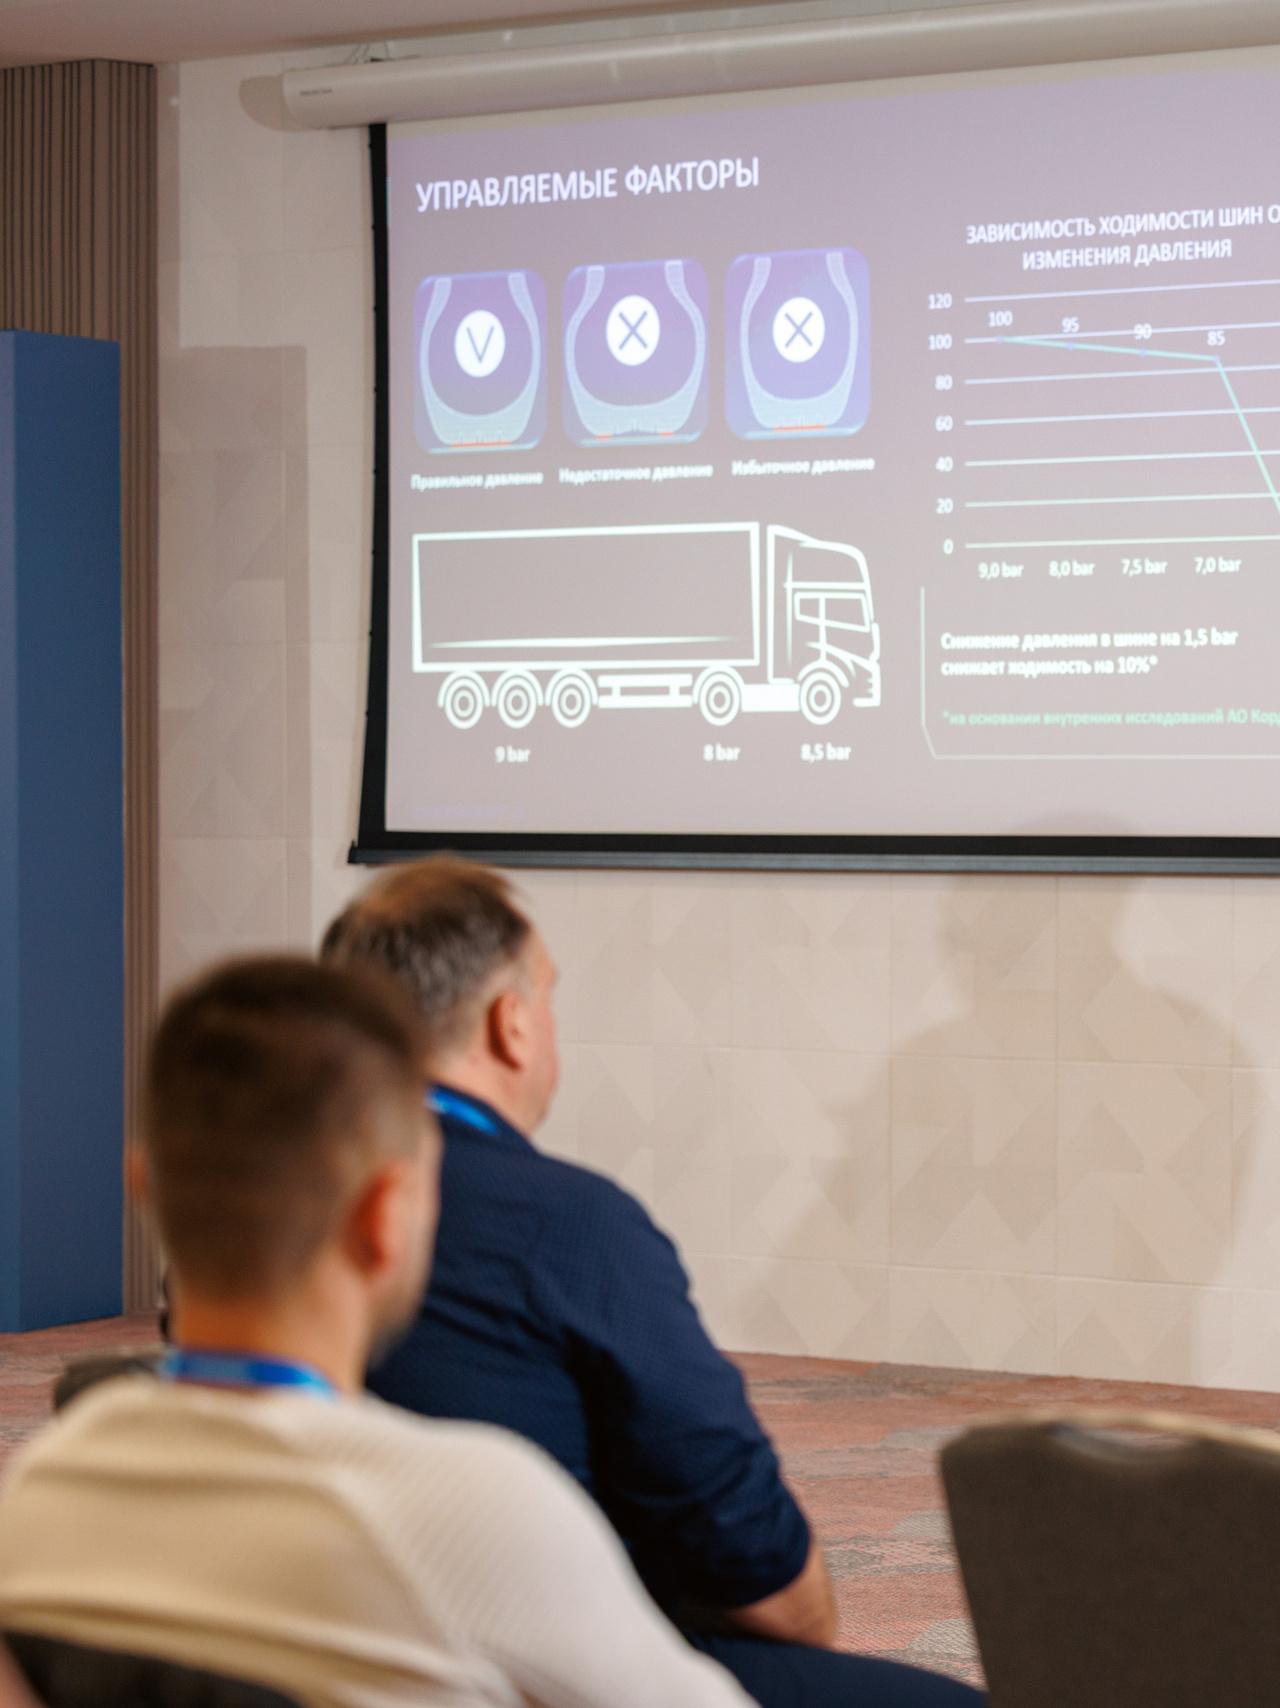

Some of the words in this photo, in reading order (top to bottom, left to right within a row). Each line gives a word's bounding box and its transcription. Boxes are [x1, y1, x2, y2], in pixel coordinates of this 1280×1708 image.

[415, 167, 618, 212] УПРАВЛЯЕМЫЕ
[625, 157, 760, 196] ФАКТОРЫ
[966, 216, 1096, 245] ЗАВИСИМОСТЬ
[1098, 208, 1214, 238] ХОДИМОСТИ
[1218, 205, 1263, 228] ШИН
[1022, 245, 1131, 271] ИЗМЕНЕНИЯ
[1134, 238, 1233, 267] ДАВЛЕНИЯ
[928, 293, 953, 310] 120
[988, 311, 1013, 327] 100
[1061, 317, 1080, 333] 95
[1133, 323, 1152, 340] 90
[1207, 330, 1226, 346] 85
[928, 334, 953, 350] 100
[935, 374, 953, 391] 80
[935, 416, 953, 432] 60
[731, 458, 810, 476] Избыточное
[811, 457, 875, 476] давление
[935, 456, 954, 472] 40
[410, 474, 484, 492] Правильное
[484, 472, 544, 490] давление
[558, 467, 651, 486] Недостаточное
[651, 464, 713, 483] давление
[936, 498, 954, 514] 20
[943, 539, 954, 555] 0
[978, 562, 1000, 580] 9,0
[1001, 562, 1024, 578] bar
[1049, 560, 1071, 579] 8,0
[1072, 560, 1095, 577] bar
[1121, 558, 1143, 578] 7,5
[1144, 557, 1168, 575] bar
[1194, 557, 1217, 576] 7,0
[1218, 556, 1242, 573] bar
[940, 631, 1020, 650] Снижение
[1021, 633, 1099, 653] давления
[1100, 633, 1112, 647] в
[1113, 631, 1158, 648] шине
[1160, 631, 1181, 647] на
[1183, 628, 1209, 649] 1,5
[1210, 627, 1239, 646] bar
[940, 661, 1006, 676] снижает
[1007, 659, 1092, 679] ходимость
[1094, 660, 1115, 675] на
[968, 712, 1042, 726] основании
[1043, 712, 1123, 729] внутренних
[1125, 707, 1224, 728] исследований
[1226, 708, 1248, 724] АО
[495, 746, 507, 763] 9
[508, 744, 532, 763] bar
[703, 744, 715, 762] 8
[716, 743, 741, 761] bar
[801, 743, 824, 764] 8,5
[826, 742, 852, 761] bar
